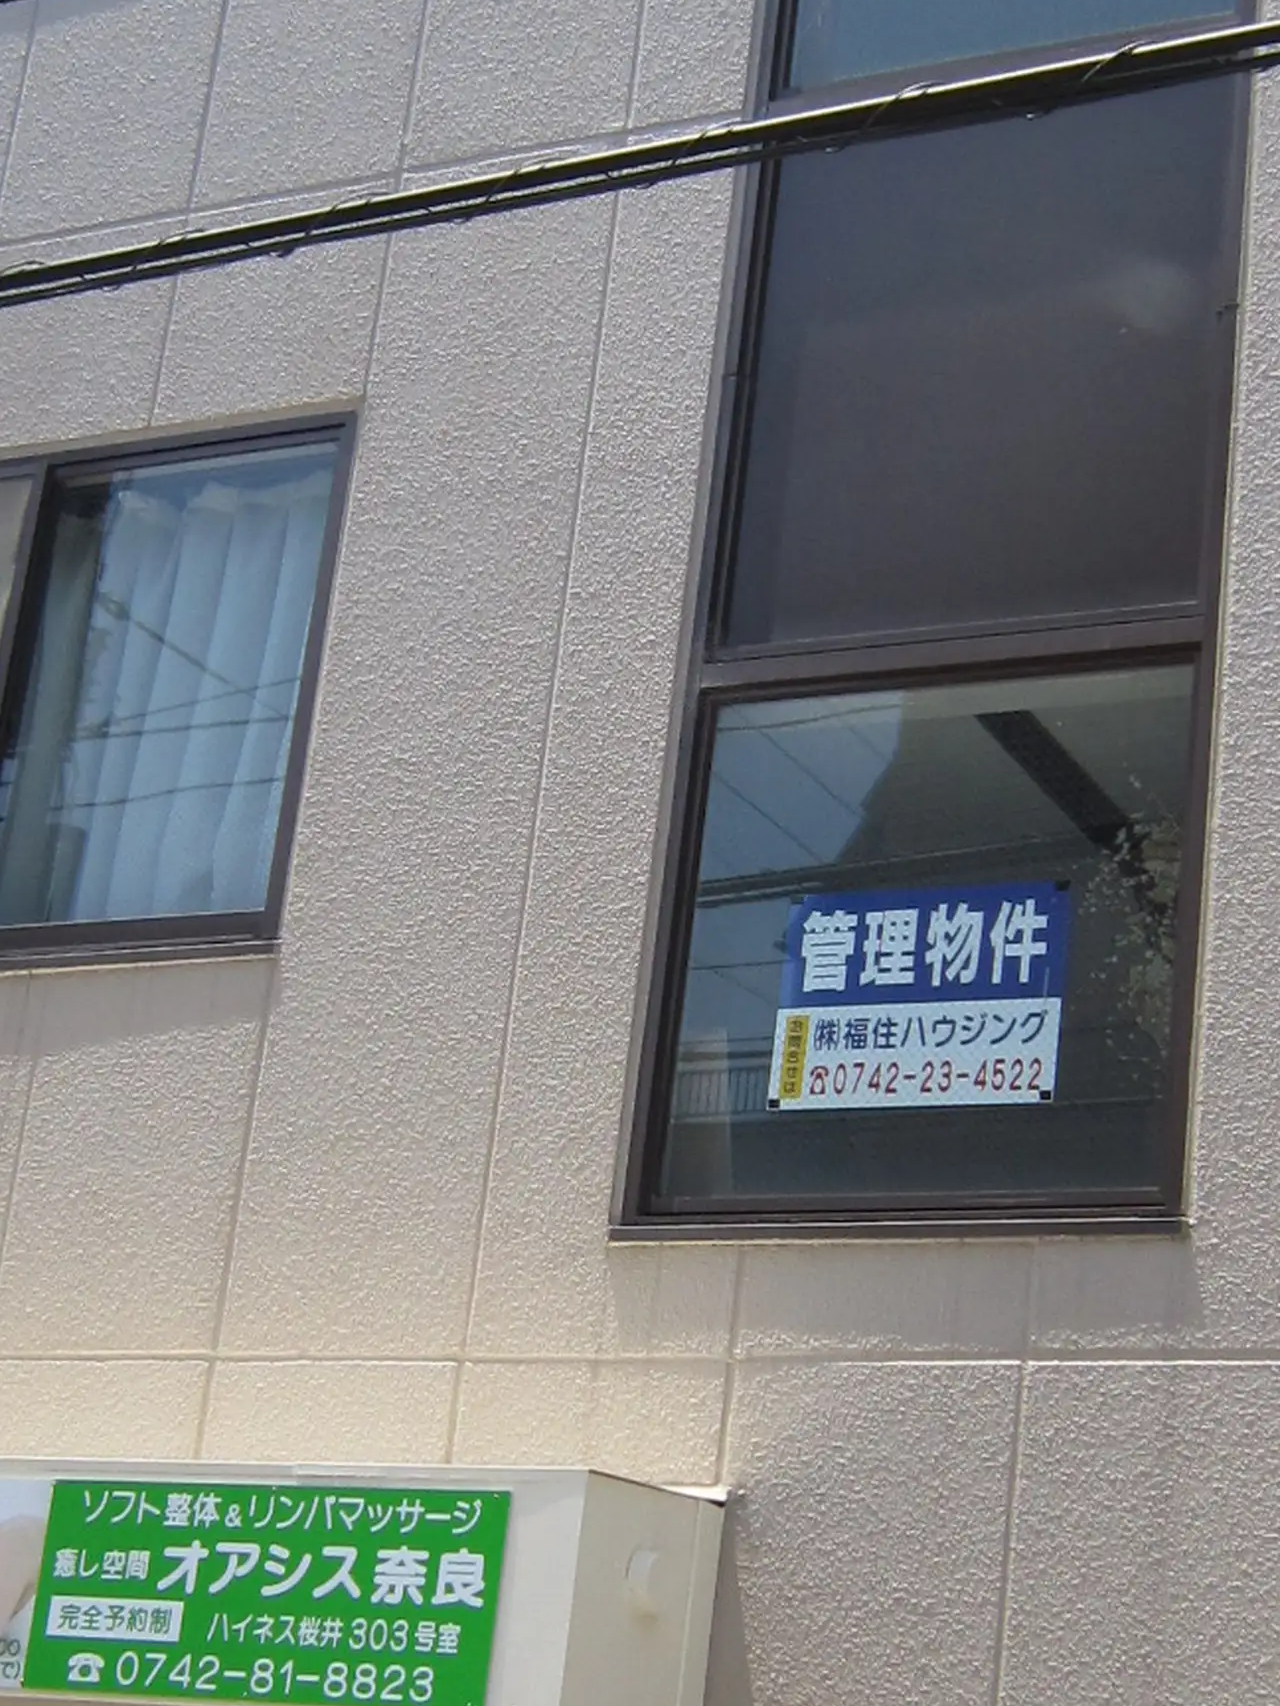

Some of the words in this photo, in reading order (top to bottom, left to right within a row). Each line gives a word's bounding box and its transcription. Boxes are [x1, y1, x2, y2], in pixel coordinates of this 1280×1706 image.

[801, 898, 1049, 993] 管理物件
[832, 1057, 1043, 1095] 0742-23-4522
[156, 1539, 485, 1608] オアシス奈良
[57, 1604, 173, 1635] 完全予約制
[115, 1650, 435, 1703] 0742-81-8823
